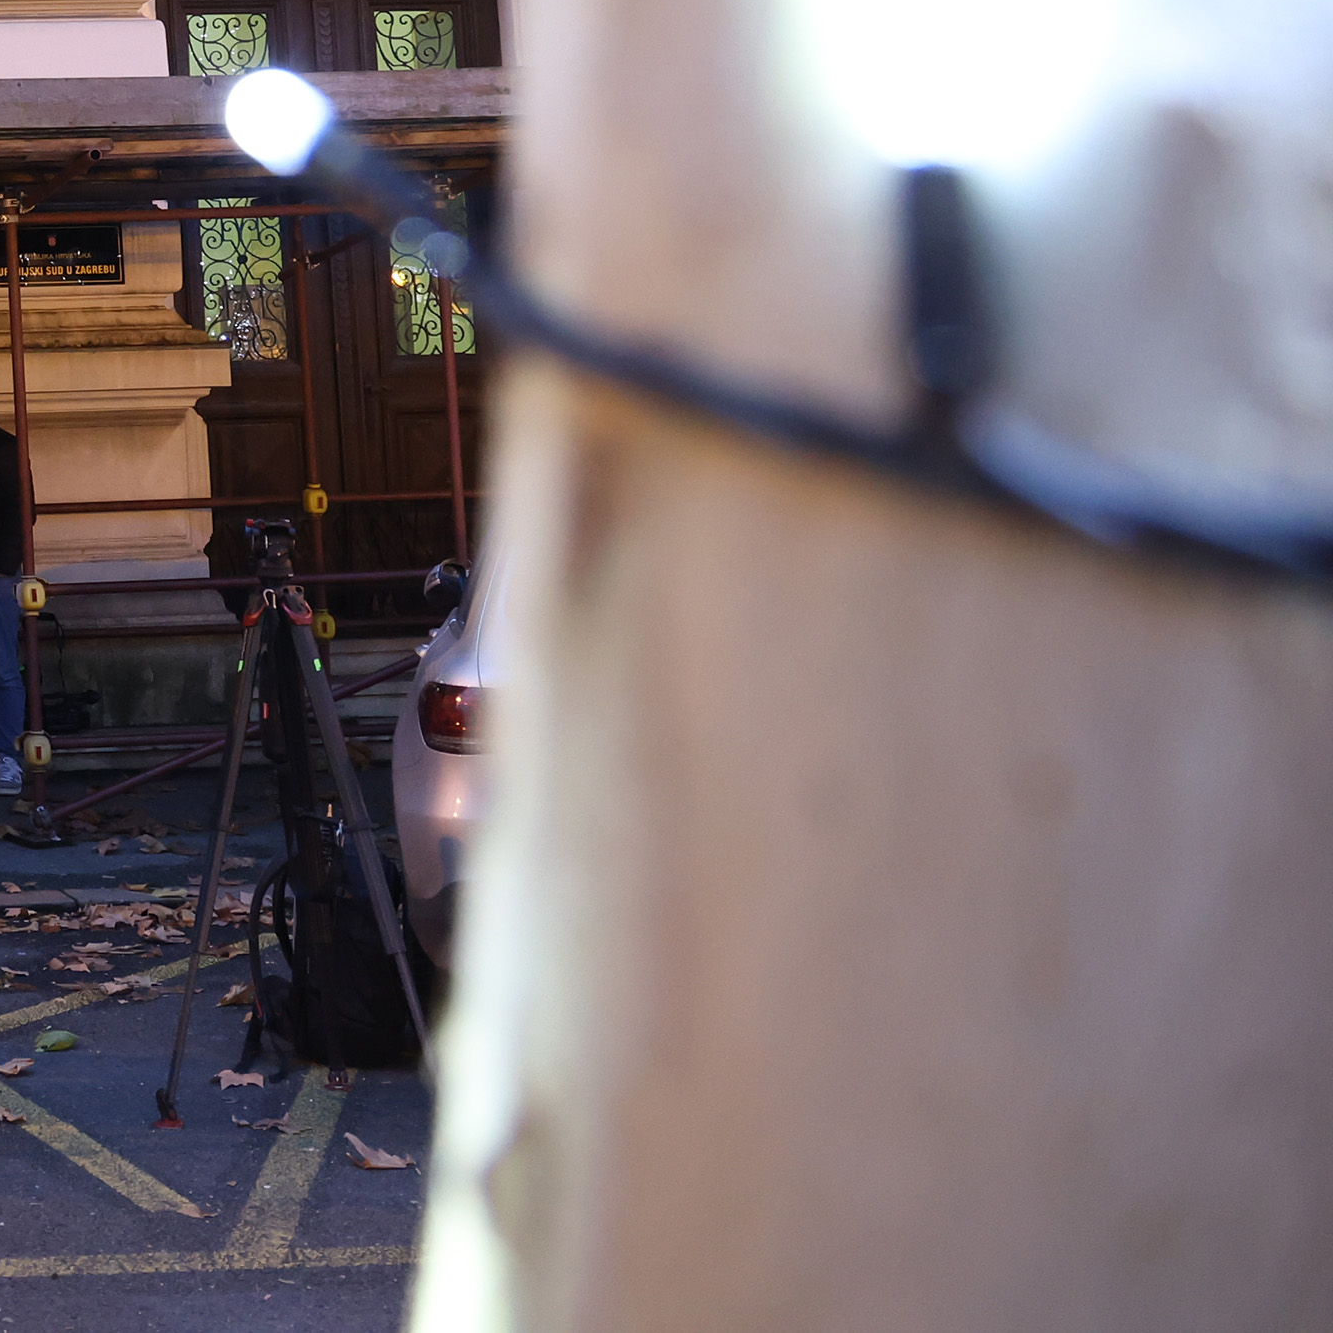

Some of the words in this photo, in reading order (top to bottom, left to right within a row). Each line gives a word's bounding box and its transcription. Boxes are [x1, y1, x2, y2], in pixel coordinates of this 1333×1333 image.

[45, 266, 64, 276] SUD
[66, 266, 73, 275] U
[75, 264, 116, 275] ZAGREBU
